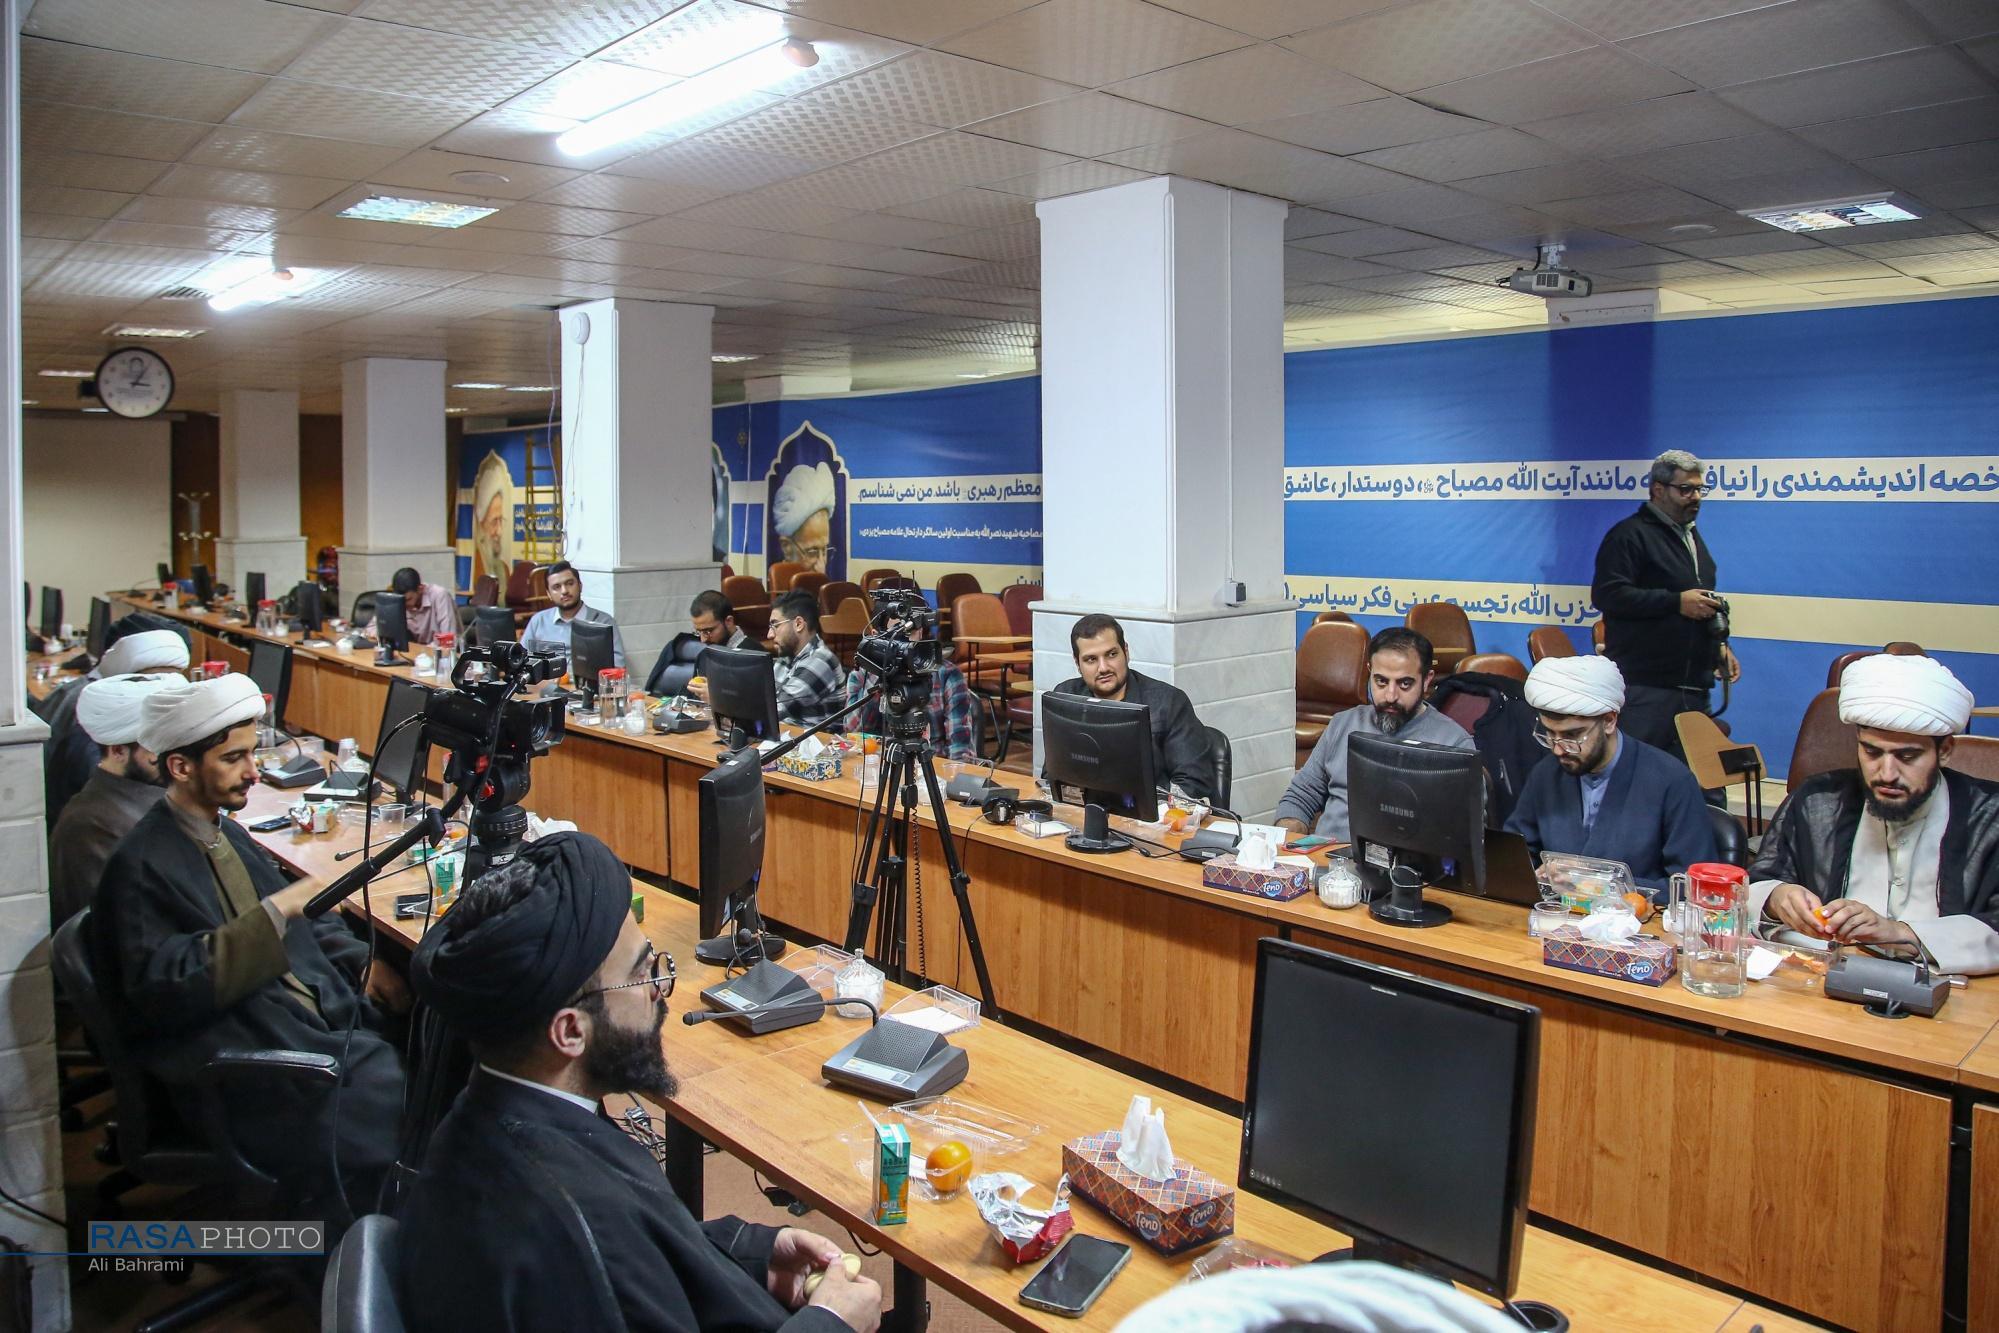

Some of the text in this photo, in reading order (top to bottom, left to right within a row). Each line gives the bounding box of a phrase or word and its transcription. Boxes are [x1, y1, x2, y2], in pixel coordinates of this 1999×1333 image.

[1283, 471, 1330, 498] عاشق
[1436, 468, 1504, 498] مصباح
[1506, 461, 1538, 491] الله
[1541, 465, 1581, 497] آیت
[1580, 466, 1637, 491] مانند
[1705, 464, 1749, 497] نیاف
[1751, 465, 1768, 498] را
[1772, 463, 1926, 498] اندیشمندی
[917, 487, 933, 502] من
[967, 484, 1003, 501] رهبری
[1003, 478, 1042, 501] معظم
[1359, 585, 1392, 612] فکر
[1380, 803, 1415, 818] SAMSUNG
[1626, 962, 1650, 975] Teno
[1135, 1210, 1158, 1231] Teno
[1189, 1204, 1214, 1227] Teno
